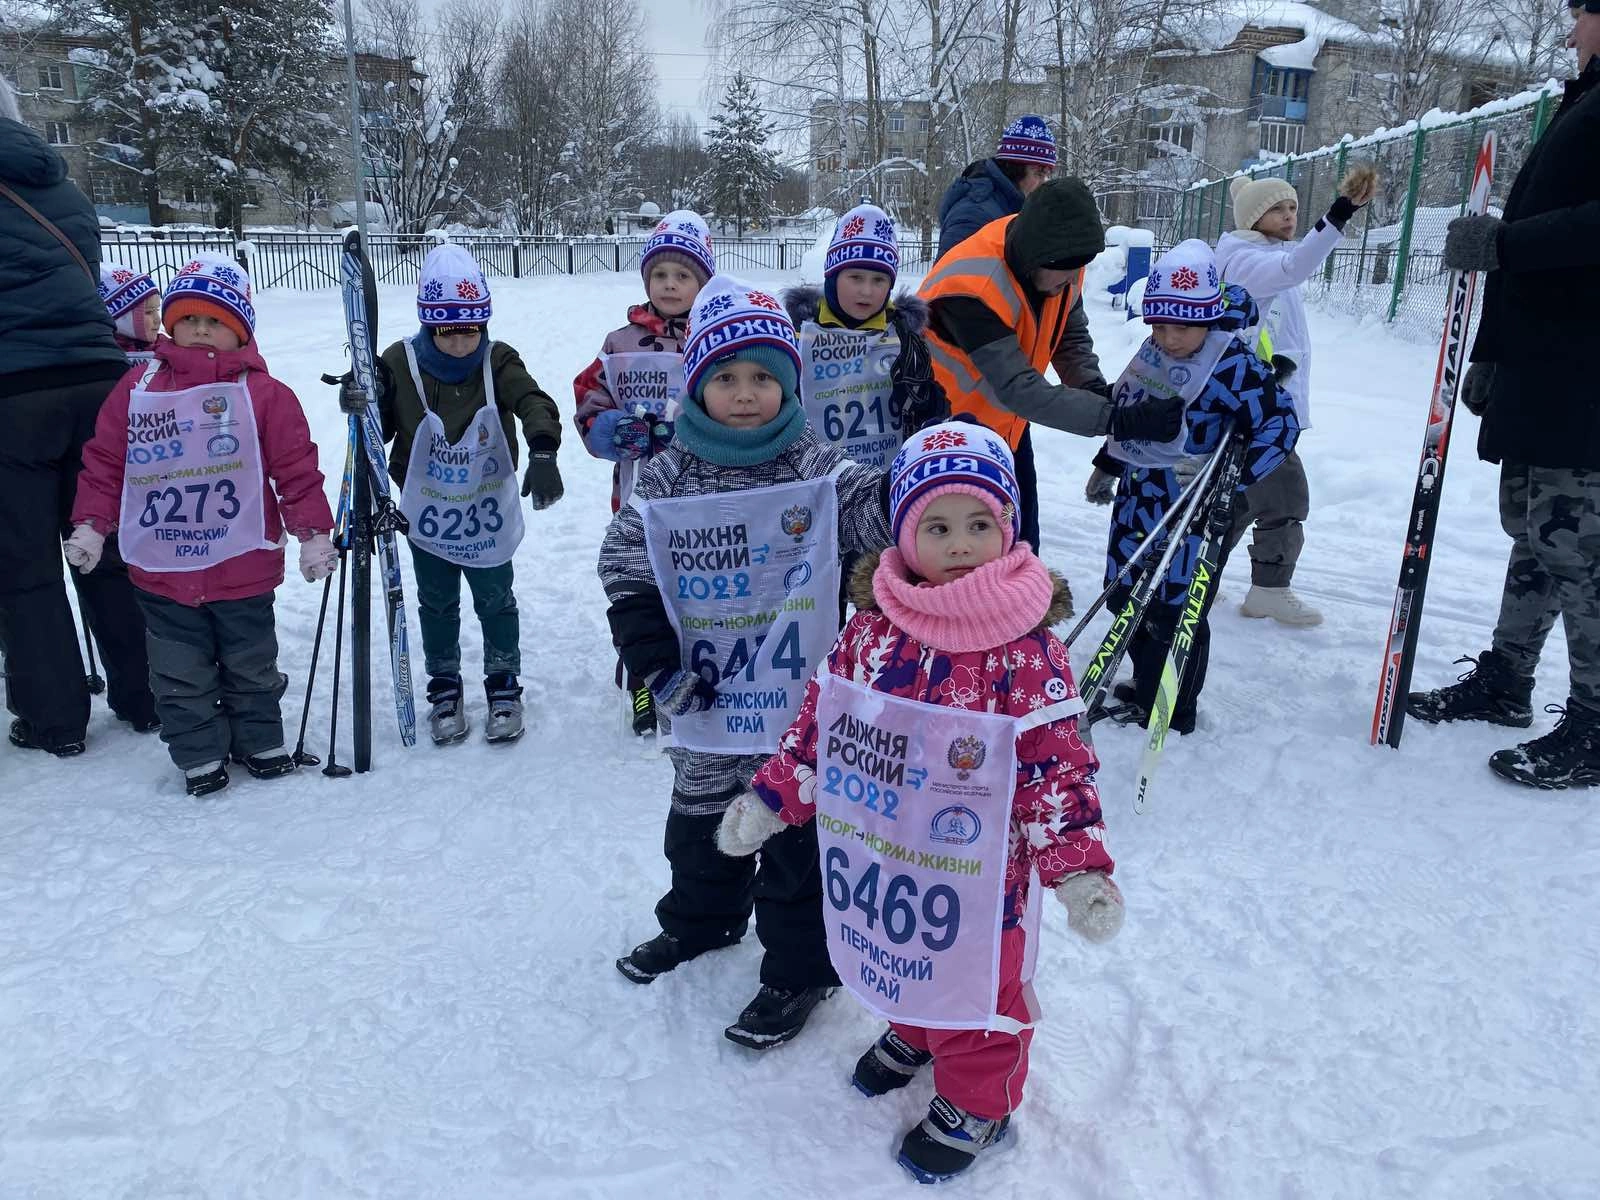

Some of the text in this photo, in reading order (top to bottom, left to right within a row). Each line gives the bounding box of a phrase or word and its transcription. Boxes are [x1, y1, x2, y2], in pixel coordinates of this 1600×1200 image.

[105, 280, 150, 316] ЫЖНЯ
[1144, 302, 1205, 318] ЫЖНЯ
[697, 319, 797, 360] ЛЫЖНЯ
[812, 344, 867, 362] РОССИИ
[617, 371, 668, 385] ЛЫЖНЯ
[815, 358, 863, 380] 2022
[618, 385, 667, 400] РОССИИ
[128, 408, 175, 428] ЫЖНЯ
[824, 396, 902, 442] 6219
[128, 421, 179, 444] ОССИИ
[841, 435, 897, 457] ЕРМСКИЙ
[426, 460, 469, 483] 2022
[418, 497, 503, 540] 6233
[154, 524, 229, 541] ПЕРМСКИЙ
[669, 524, 747, 549] ЛЫЖНЯ
[176, 542, 209, 557] КРАЙ
[672, 547, 750, 571] РОССИИ
[677, 573, 750, 600] 2022
[1174, 562, 1211, 652] ACTIVE
[1087, 600, 1137, 687] ACTIVE
[726, 712, 764, 734] КРАЙ
[828, 712, 909, 760] ЛЫЖНЯ
[827, 736, 905, 787] РОССИИ
[822, 766, 900, 822] 2022
[818, 814, 982, 877] СПОРТ НОРМА ЖИЗНИ
[825, 846, 961, 952] 6469
[840, 922, 934, 982] ПЕРМСКИЙ
[860, 963, 901, 1004] КРАЙ
[933, 1099, 956, 1122] spine
